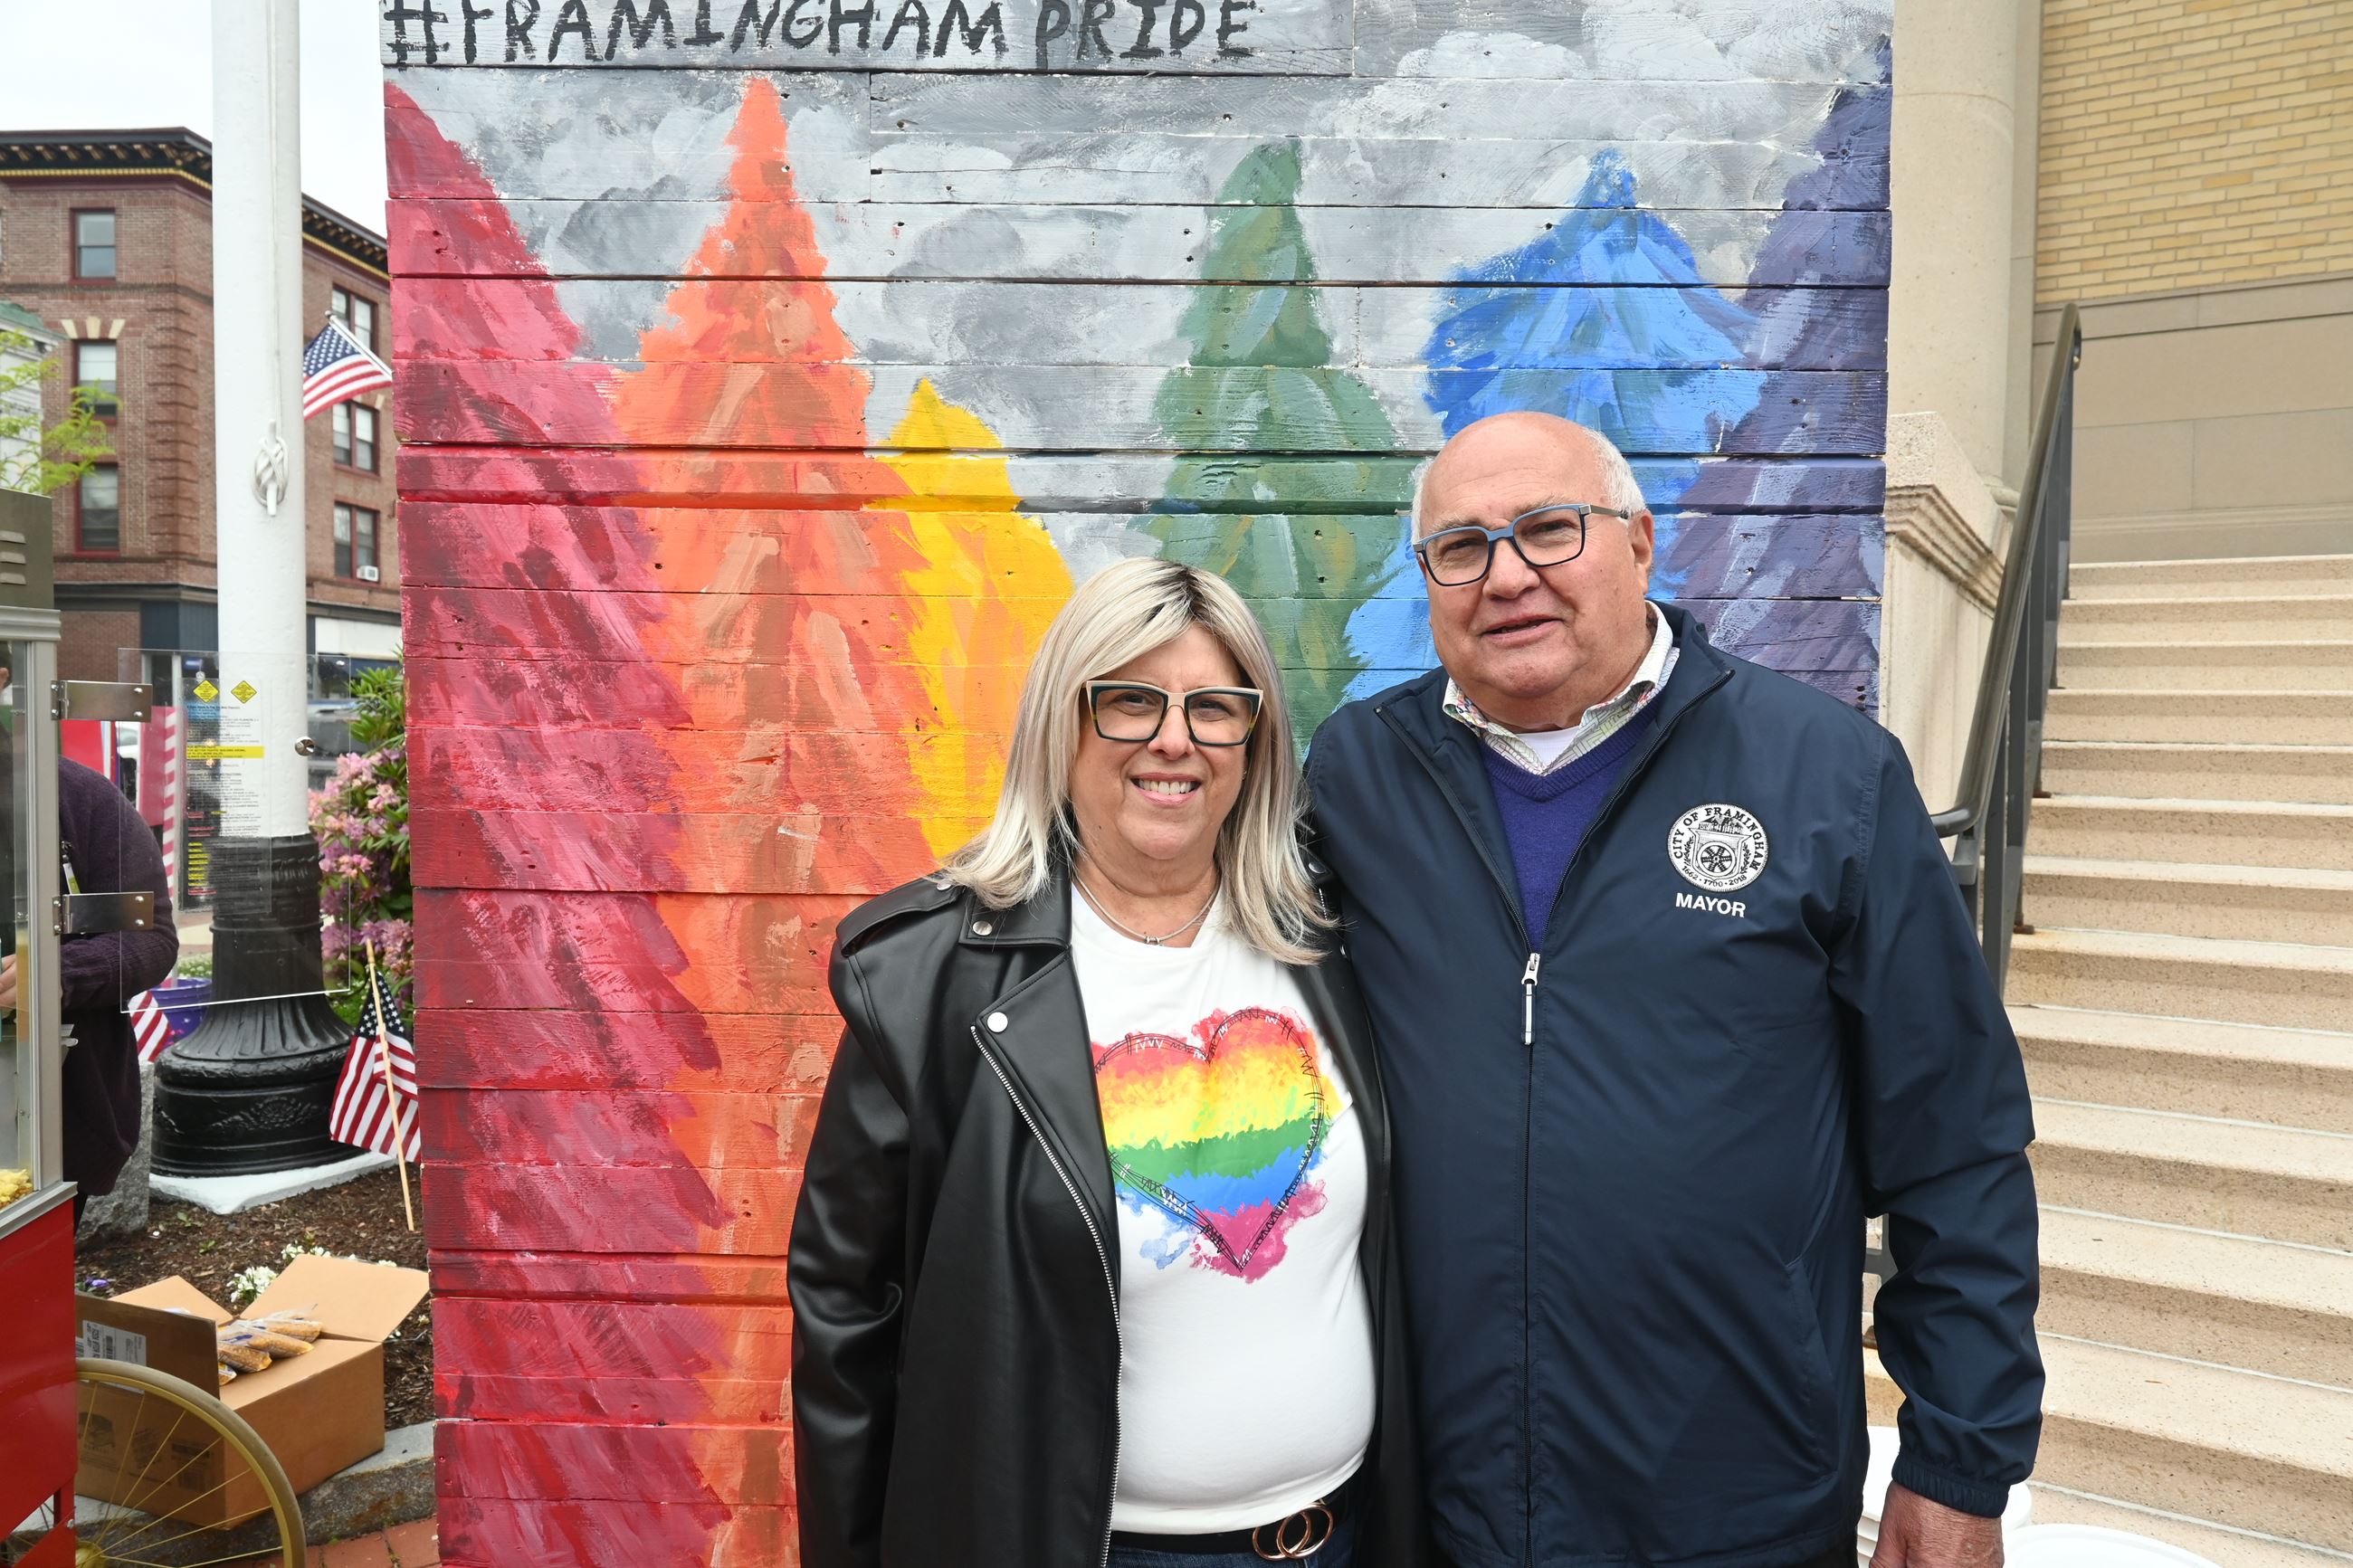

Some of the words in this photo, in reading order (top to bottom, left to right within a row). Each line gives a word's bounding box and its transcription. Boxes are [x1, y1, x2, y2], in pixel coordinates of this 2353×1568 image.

[383, 0, 1010, 64] #FRAMINGHAM
[1034, 0, 1257, 70] PRIDE
[1672, 829, 1684, 859] CITY
[1683, 813, 1699, 826] OF
[1705, 807, 1764, 870] FRAMINGHAM
[1681, 866, 1699, 879] 1662
[1703, 879, 1724, 887] 1700
[1729, 874, 1748, 886] 2018
[1675, 893, 1746, 917] MAYOR
